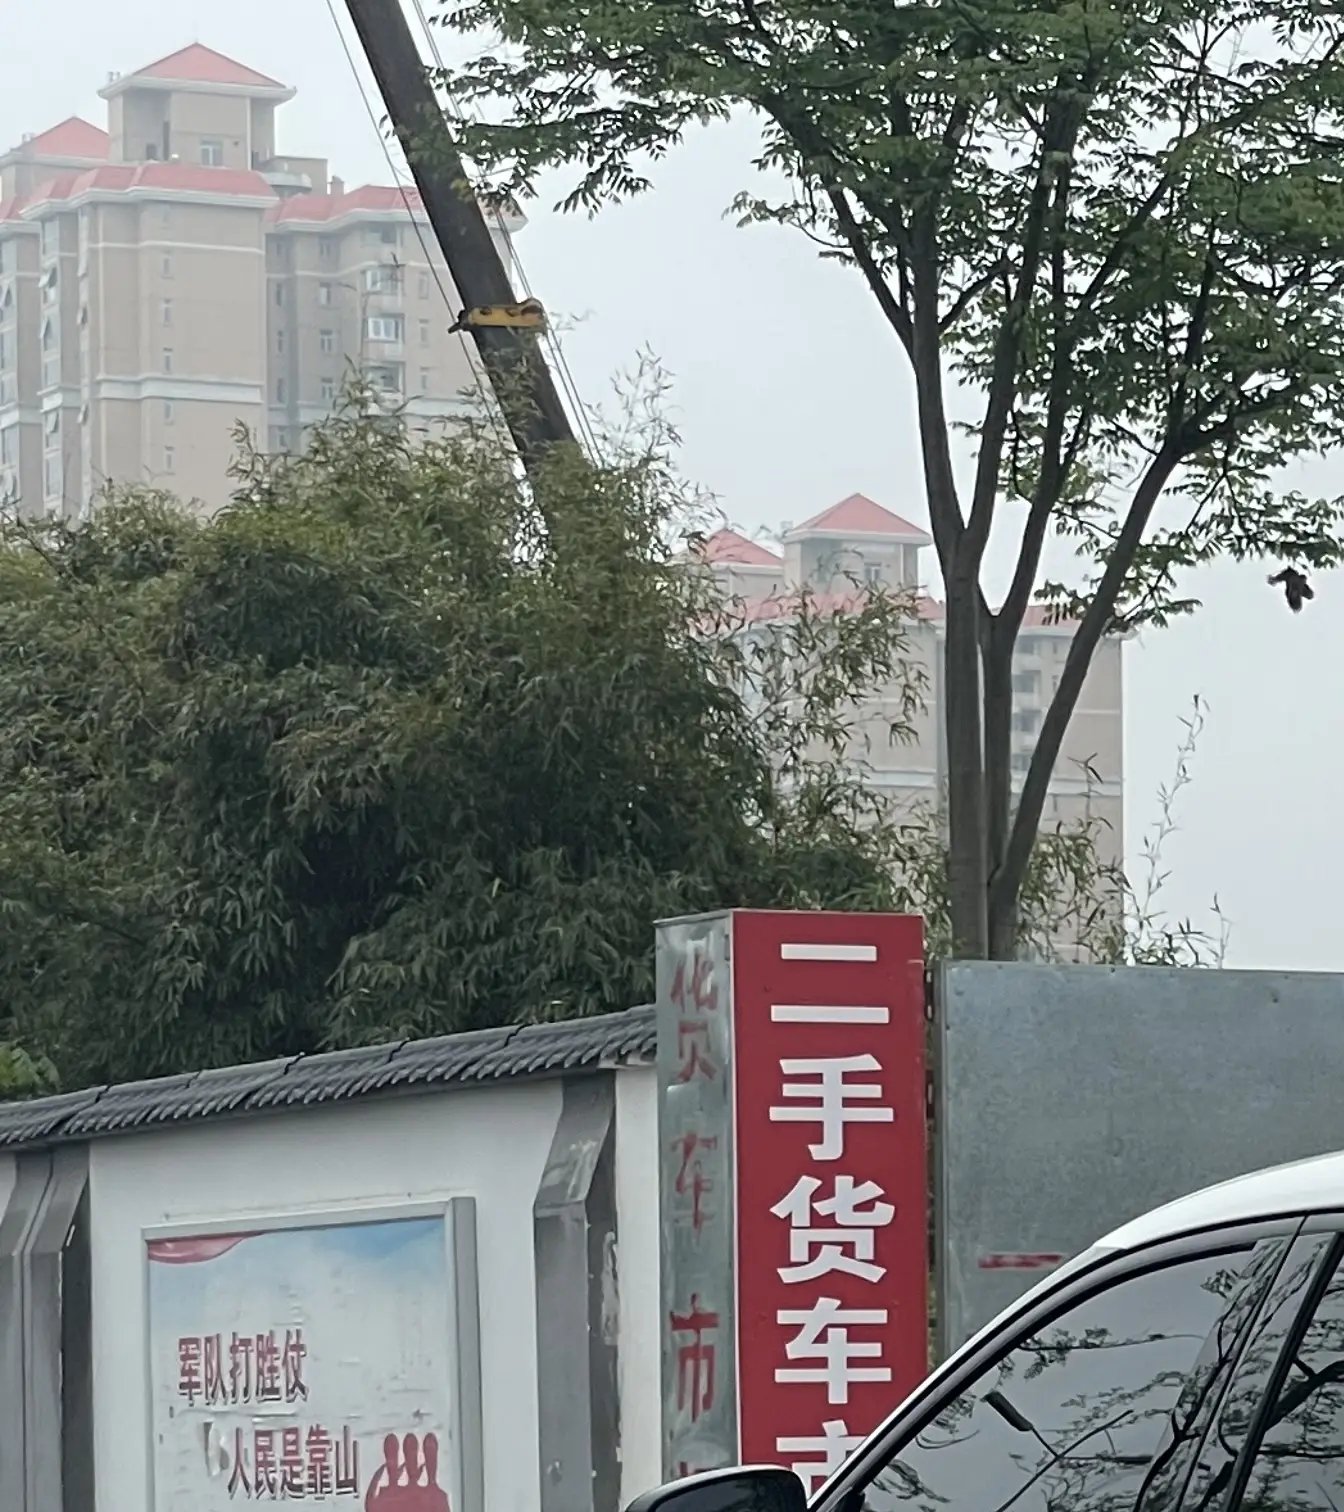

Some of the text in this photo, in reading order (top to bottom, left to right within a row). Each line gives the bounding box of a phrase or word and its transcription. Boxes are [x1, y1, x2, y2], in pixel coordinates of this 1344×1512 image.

[178, 1330, 309, 1405] 军队打胜仗
[227, 1425, 360, 1500] 人民是靠山
